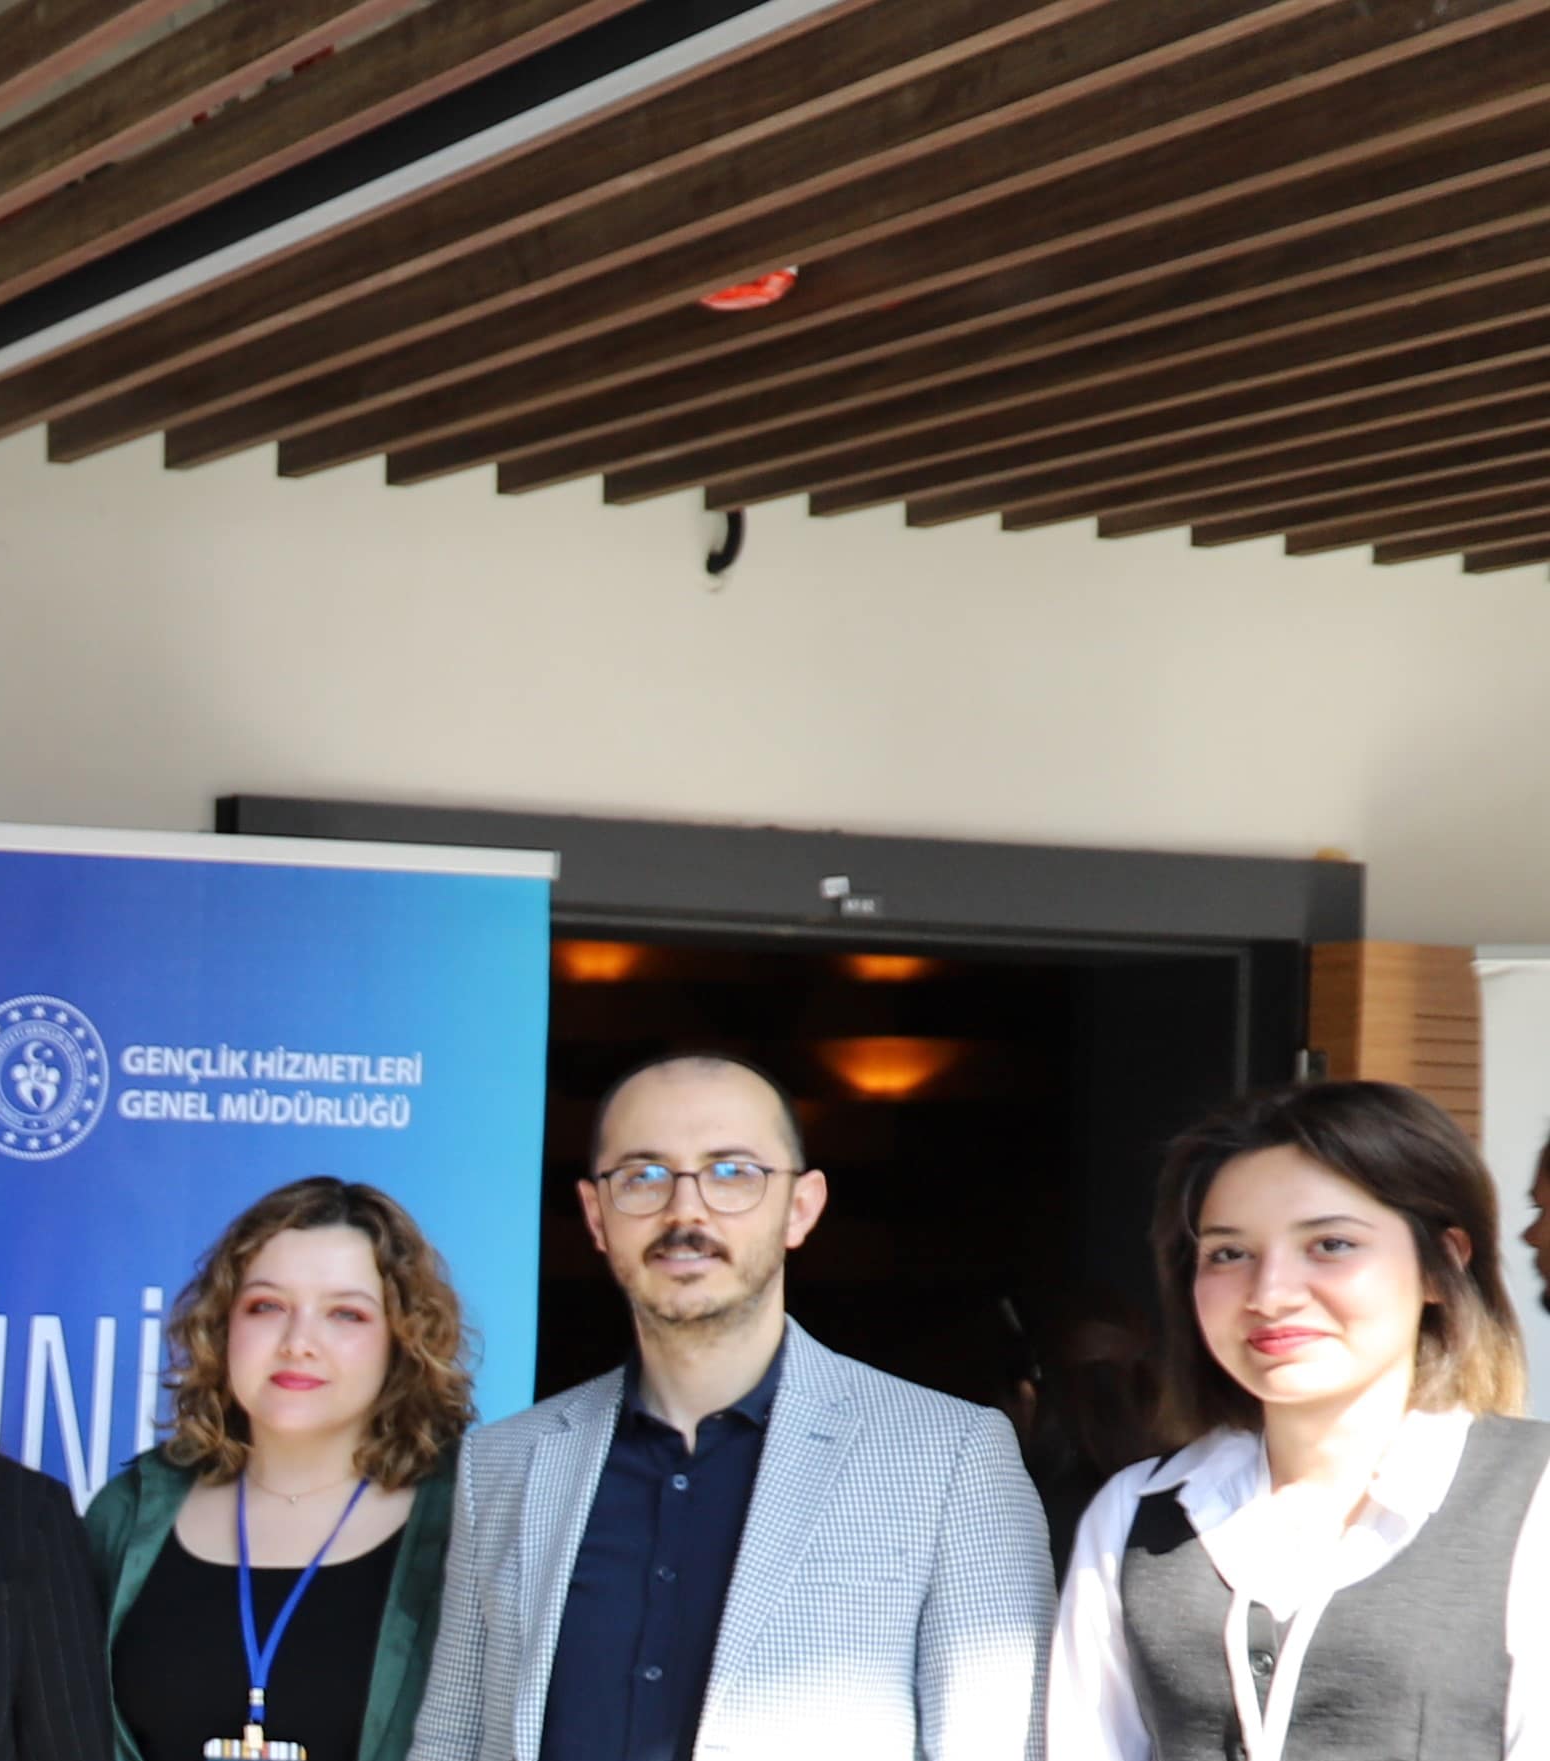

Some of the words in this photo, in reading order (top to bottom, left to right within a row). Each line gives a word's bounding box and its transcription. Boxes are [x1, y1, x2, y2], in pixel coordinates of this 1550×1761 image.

[120, 1042, 249, 1084] GENÇLİK
[254, 1045, 423, 1086] HİZMETLERİ
[118, 1089, 215, 1122] GENEL
[220, 1088, 411, 1128] MÜDÜRLÜĞÜ
